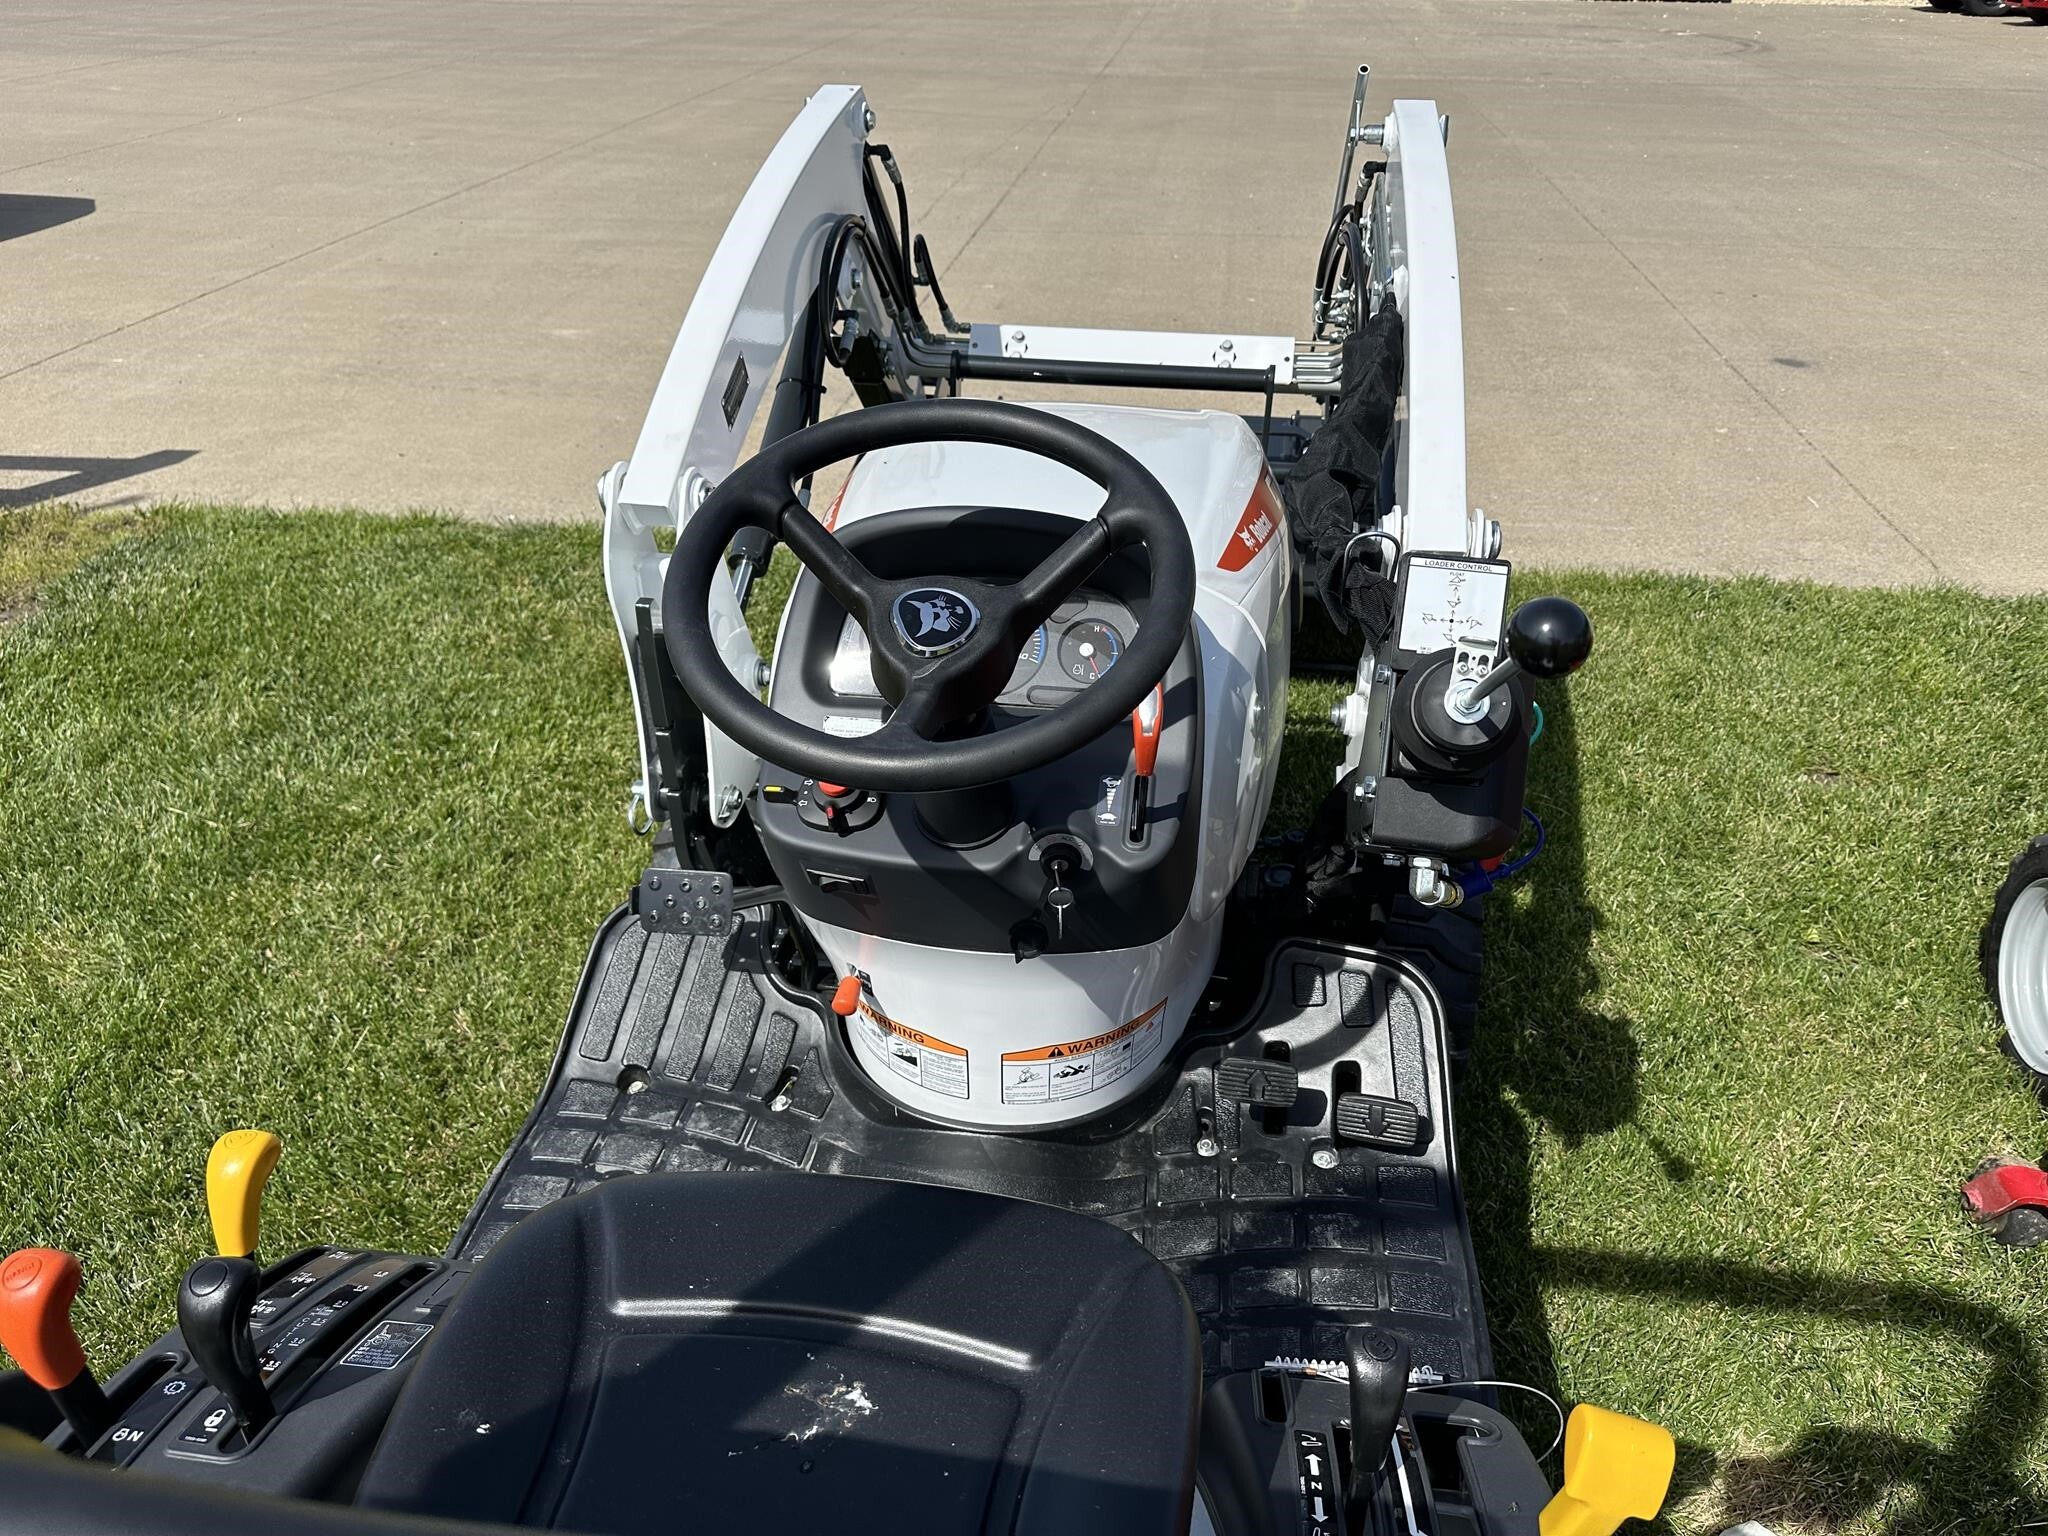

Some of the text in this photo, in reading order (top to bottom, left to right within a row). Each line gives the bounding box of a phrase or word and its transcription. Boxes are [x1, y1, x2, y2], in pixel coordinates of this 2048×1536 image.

[1424, 559, 1493, 572] LOADER CONTROL
[1089, 672, 1096, 680] C
[860, 1003, 925, 1043] WARNING
[1068, 1019, 1142, 1055] WARNING
